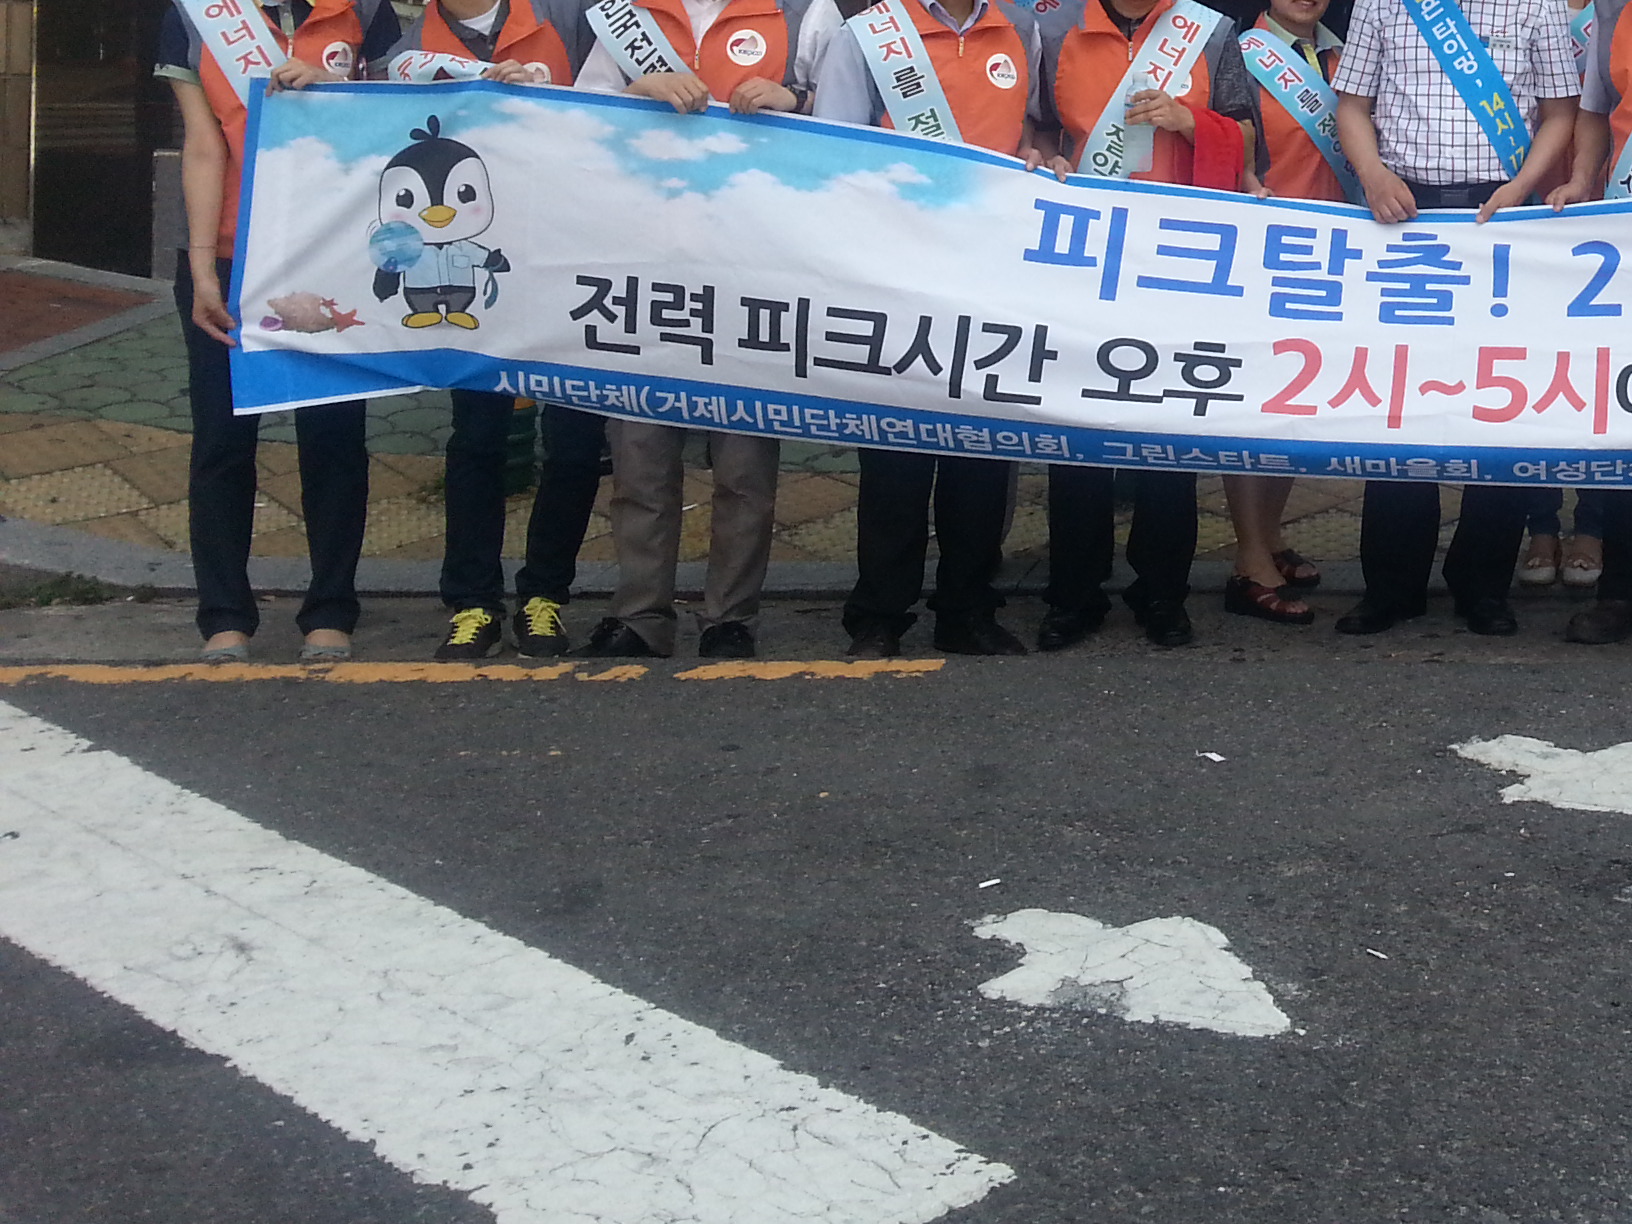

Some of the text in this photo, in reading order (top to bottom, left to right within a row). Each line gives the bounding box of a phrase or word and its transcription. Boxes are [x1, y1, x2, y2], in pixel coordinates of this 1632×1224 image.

[1240, 36, 1324, 115] 에너지를
[1022, 197, 1511, 327] 피크탈출!
[568, 273, 716, 366] 전력
[736, 294, 1058, 406] 피크시간
[1080, 335, 1245, 417] 오후
